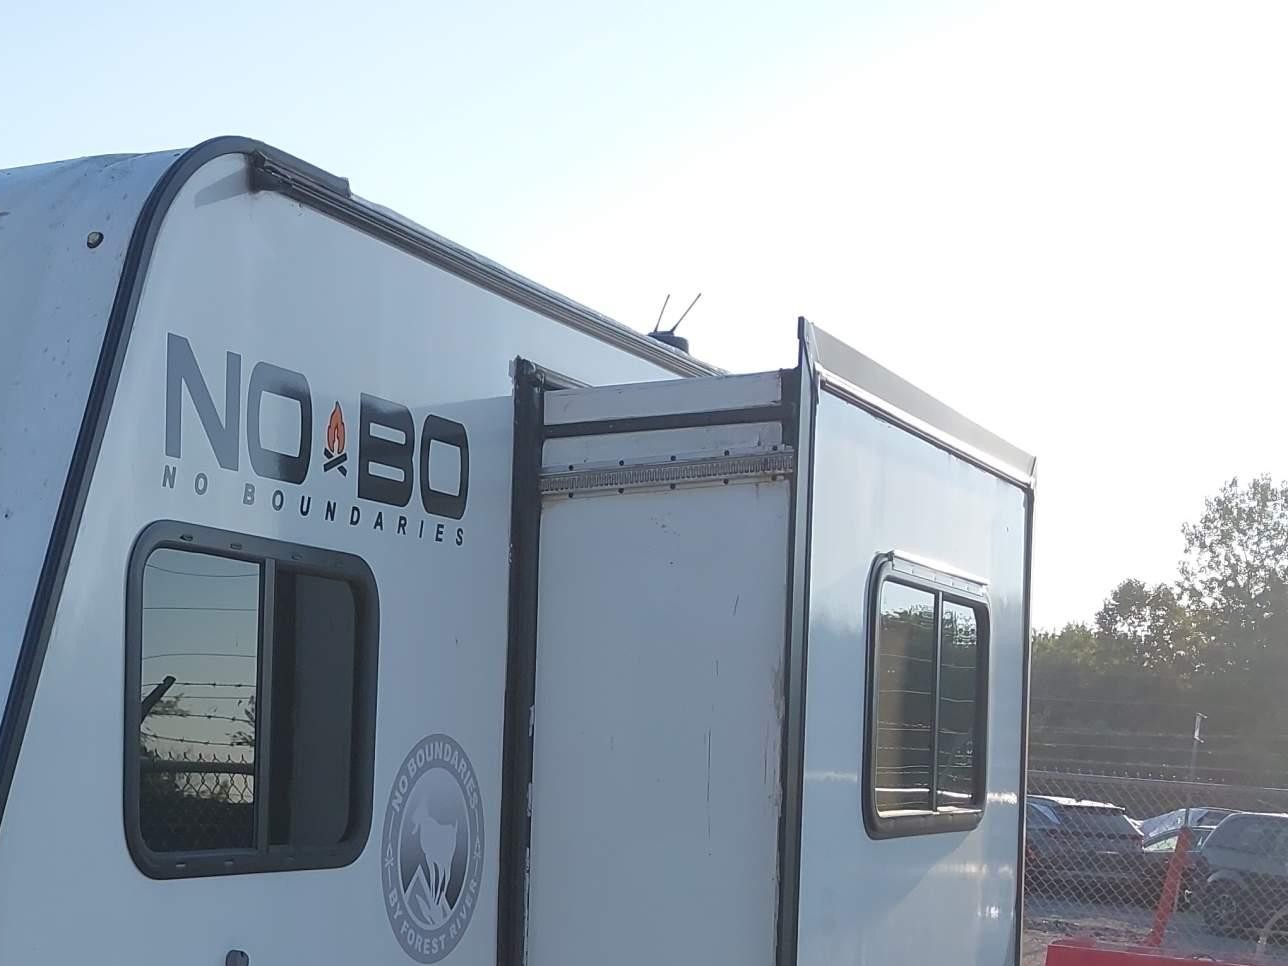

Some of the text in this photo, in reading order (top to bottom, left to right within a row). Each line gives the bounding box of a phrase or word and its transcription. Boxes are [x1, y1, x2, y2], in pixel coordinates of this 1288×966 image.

[162, 465, 465, 547] NO BOUNDARIES
[392, 741, 478, 812] NO BOUNDARIES
[388, 878, 477, 954] BY FOREST RIVER
